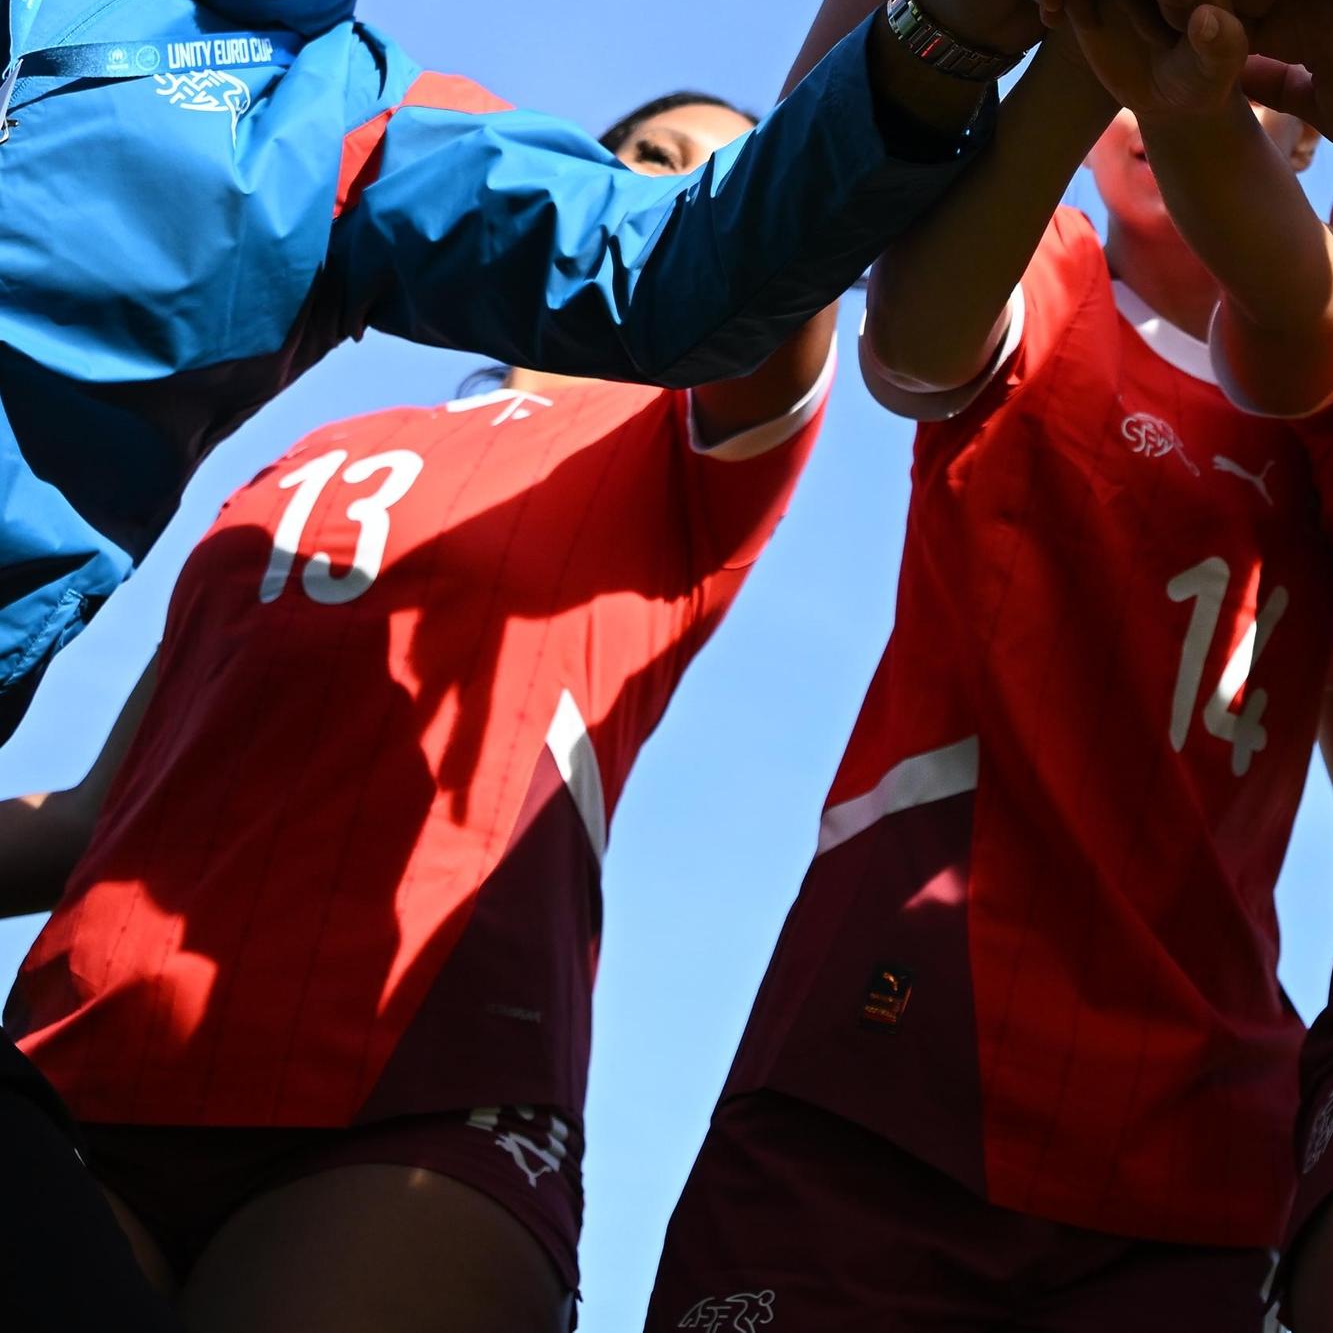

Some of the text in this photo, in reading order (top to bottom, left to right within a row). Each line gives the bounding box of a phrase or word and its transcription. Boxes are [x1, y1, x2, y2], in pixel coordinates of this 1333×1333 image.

[167, 37, 273, 69] UNITY EURO CUP
[259, 449, 424, 606] 13
[1166, 556, 1290, 777] 14
